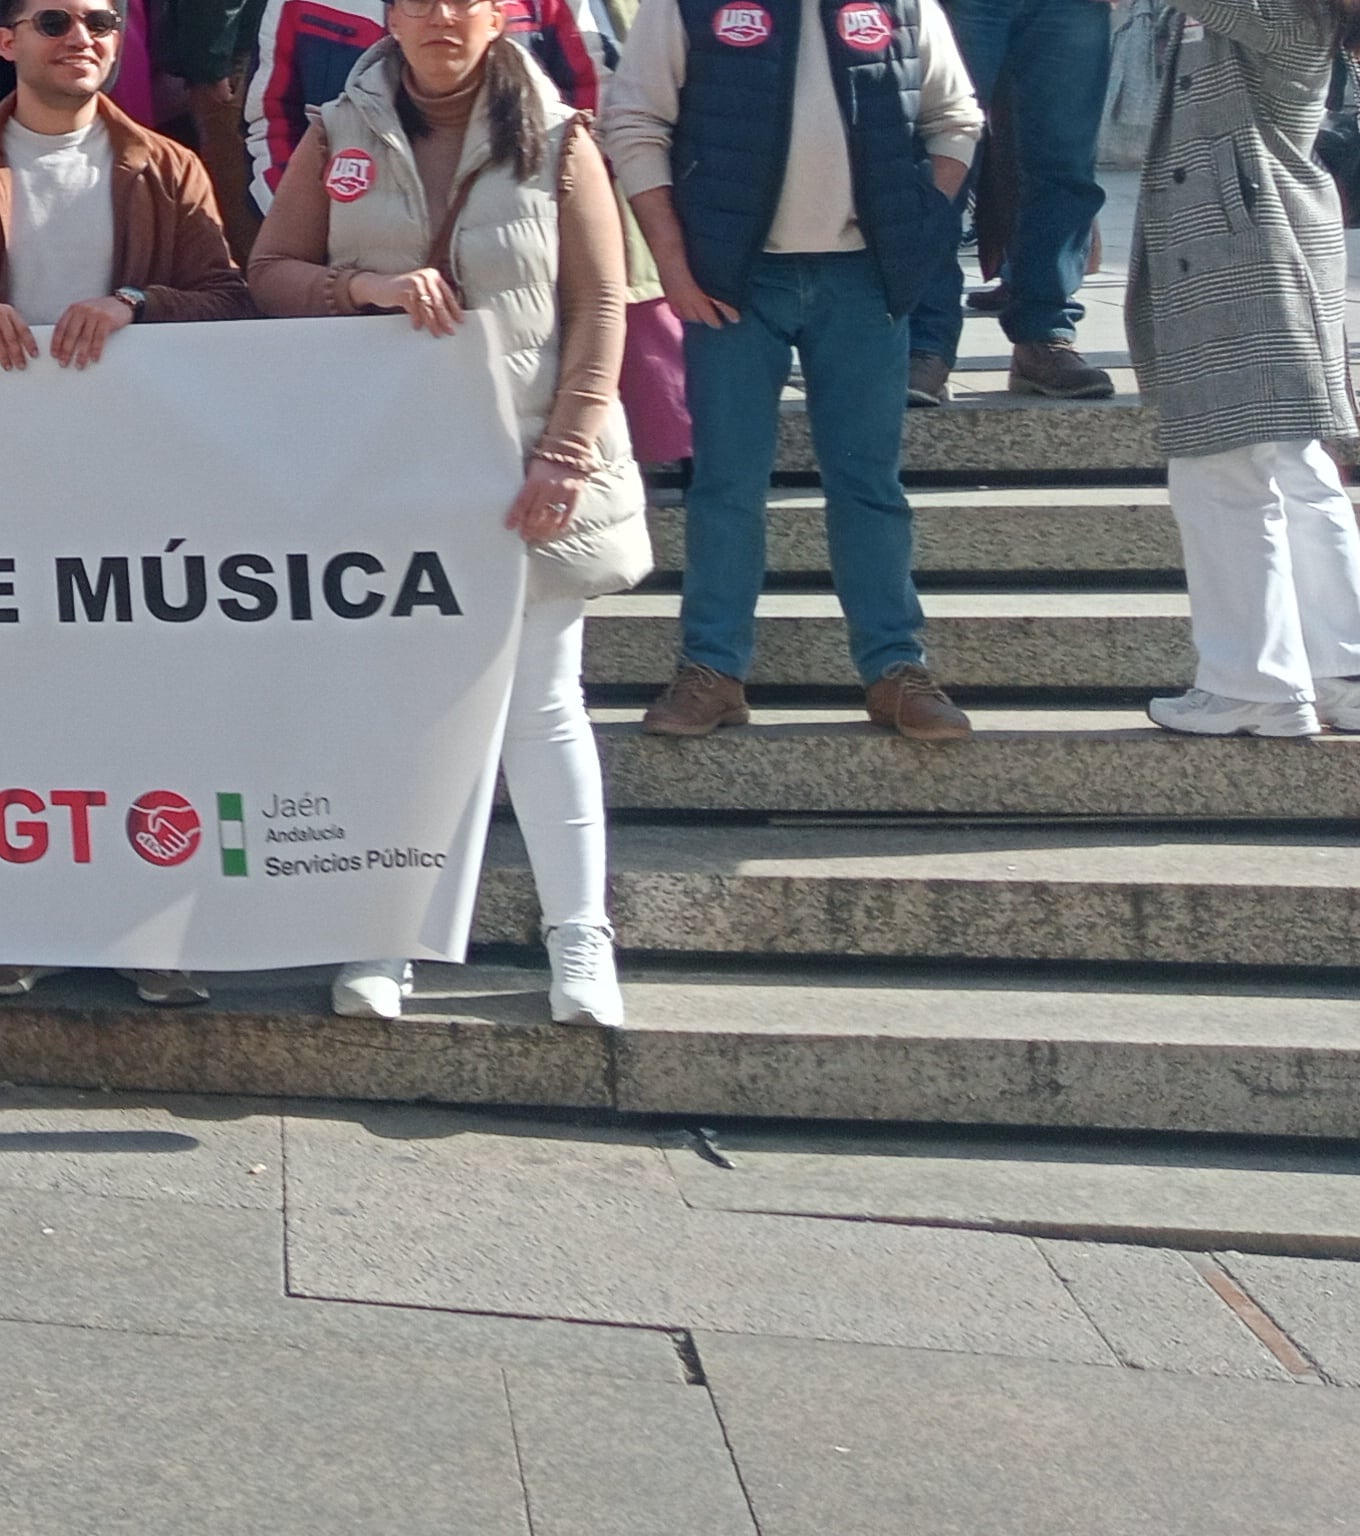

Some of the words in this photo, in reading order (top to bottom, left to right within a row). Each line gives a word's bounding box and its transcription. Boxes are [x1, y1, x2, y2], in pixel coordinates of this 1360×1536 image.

[720, 8, 764, 27] UGT
[842, 8, 885, 32] UGT
[330, 156, 372, 180] UGT
[54, 537, 465, 624] MÚSICA
[261, 792, 331, 821] Jaén
[264, 824, 347, 846] Andalucía
[264, 852, 363, 878] Servicios
